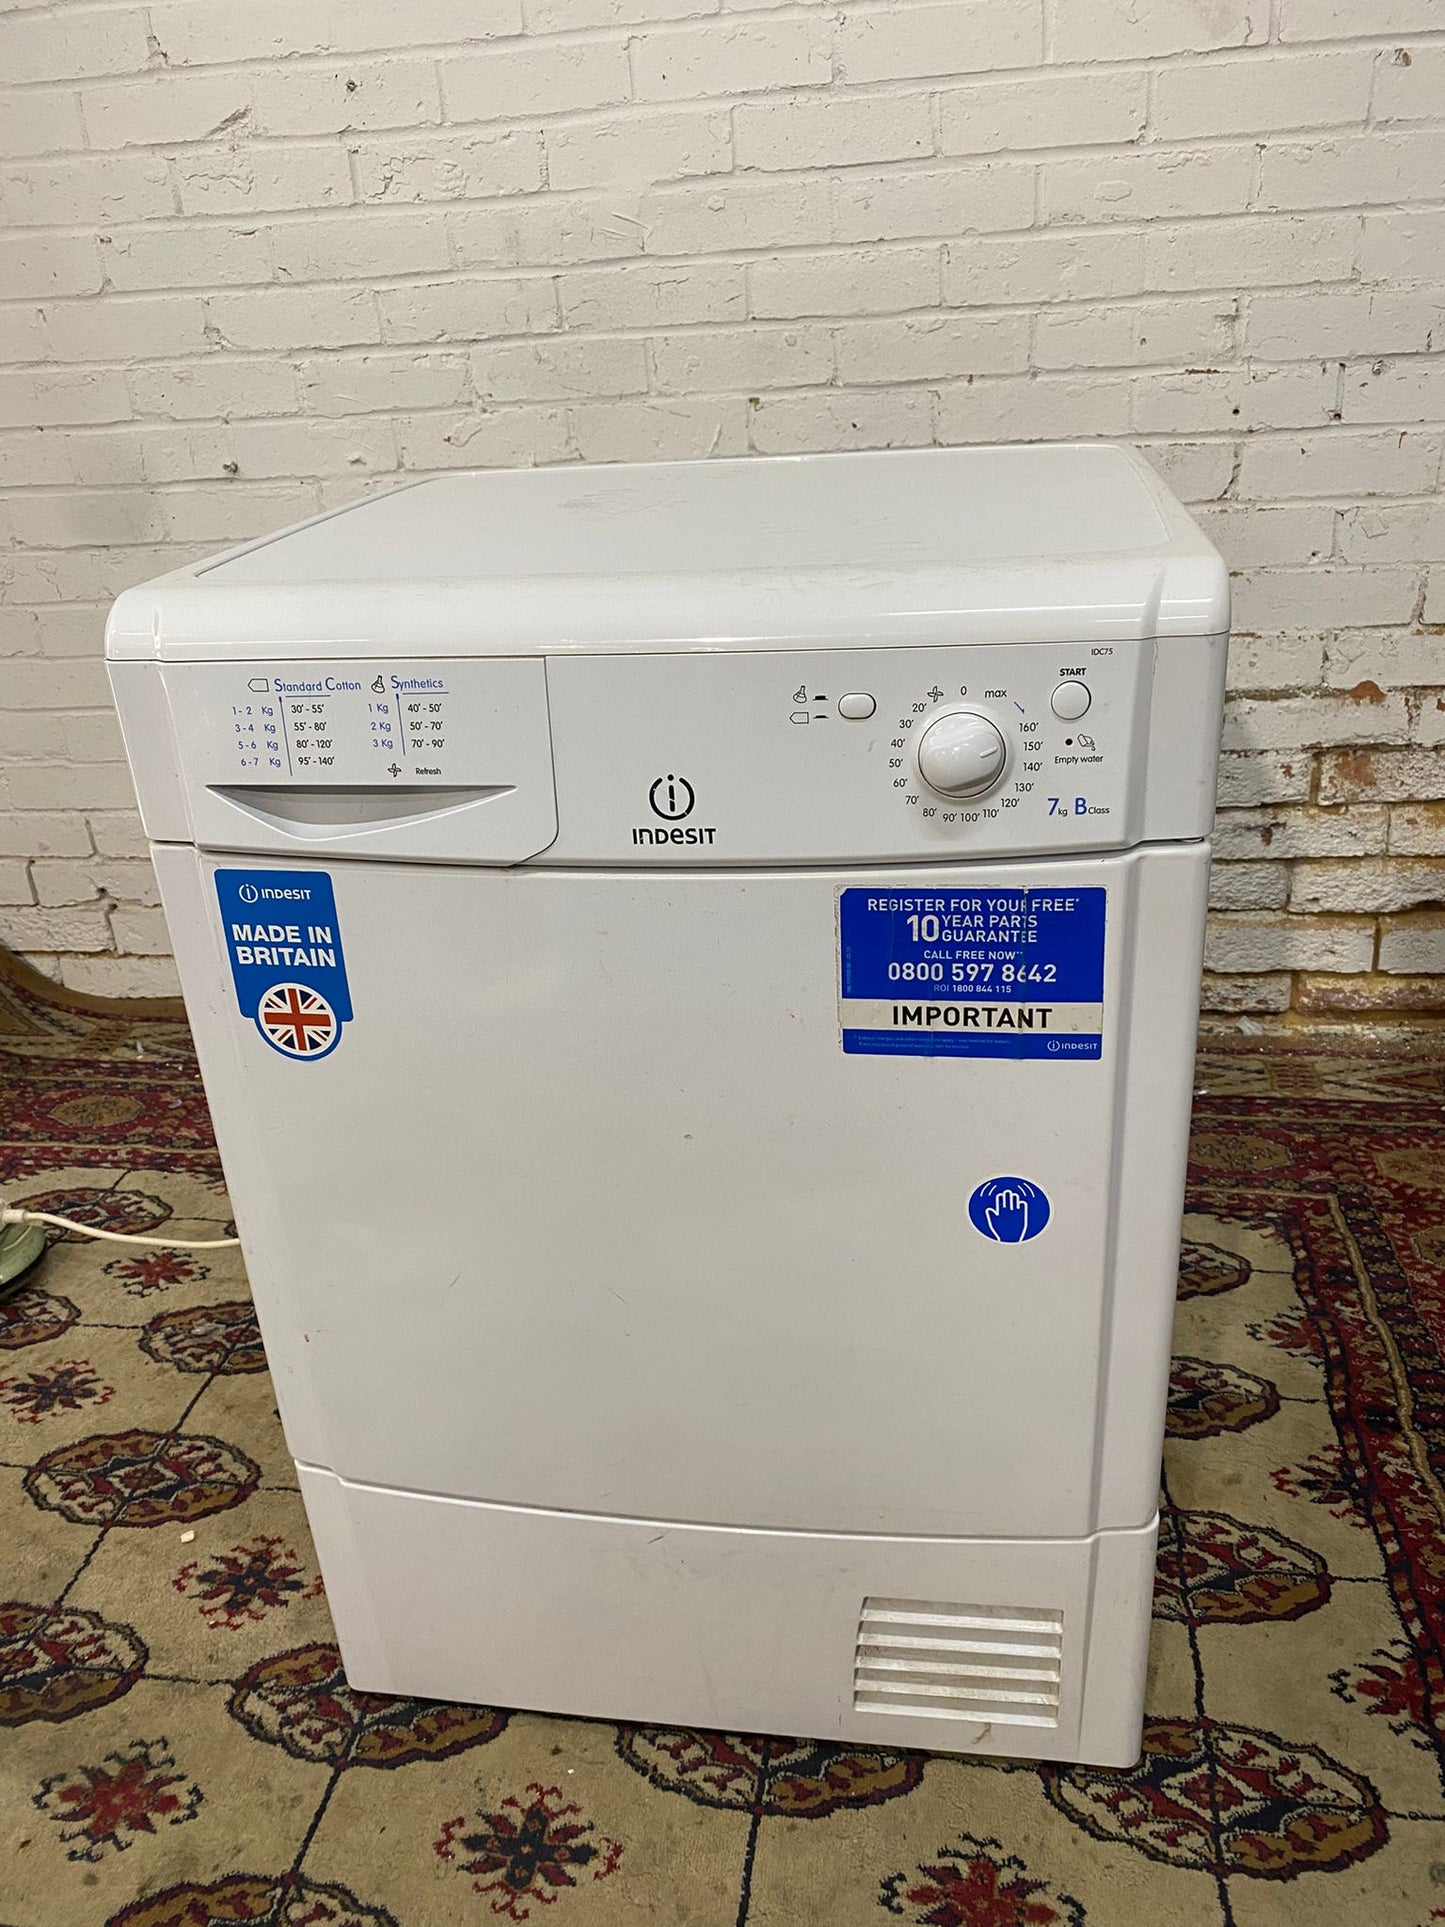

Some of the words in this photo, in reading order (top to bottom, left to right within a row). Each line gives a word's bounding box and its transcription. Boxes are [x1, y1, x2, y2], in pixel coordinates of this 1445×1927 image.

[1060, 668, 1086, 676] START
[274, 678, 322, 692] Standard
[325, 677, 361, 690] Cotton
[391, 675, 443, 691] Synthetics
[961, 686, 967, 695] 0
[985, 690, 1007, 698] max
[261, 706, 273, 716] Kg
[377, 703, 388, 714] Kg
[912, 703, 927, 712] 20'
[379, 722, 391, 732] Kg
[899, 719, 914, 728] 30'
[1019, 722, 1039, 732] 160'
[264, 724, 276, 734] Kg
[267, 741, 278, 751] Kg
[381, 739, 393, 749] Kg
[891, 739, 905, 748] 40'
[1024, 741, 1043, 751] 150'
[269, 758, 281, 768] Kg
[889, 759, 903, 768] 50'
[1055, 756, 1079, 765] Empty
[416, 767, 441, 775] Refresh
[1024, 762, 1043, 771] 140'
[893, 778, 908, 787] 60'
[1015, 783, 1034, 792] 130'
[906, 795, 919, 804] 70'
[1001, 798, 1020, 807] 120'
[923, 808, 937, 817] 80'
[943, 813, 957, 822] 90'
[961, 813, 980, 822] 100'
[983, 809, 999, 818] 110'
[868, 899, 944, 911] REGISTER
[951, 899, 981, 911] FOR
[942, 915, 983, 927] YEAR
[990, 915, 1037, 928] PARTS
[907, 915, 939, 941] 10
[232, 924, 301, 942] MADE
[308, 927, 332, 943] IN
[942, 930, 1037, 942] GUARANTEE
[236, 947, 336, 967] BRITAIN
[924, 950, 952, 959] CALL
[955, 951, 985, 960] FREE
[888, 963, 944, 982] 0800
[952, 964, 993, 981] 597
[1002, 964, 1056, 982] 8642
[934, 984, 949, 992] ROI
[952, 985, 974, 993] 1800
[975, 984, 993, 993] 844
[995, 985, 1012, 993] 115
[893, 1006, 1052, 1029] IMPORTANT
